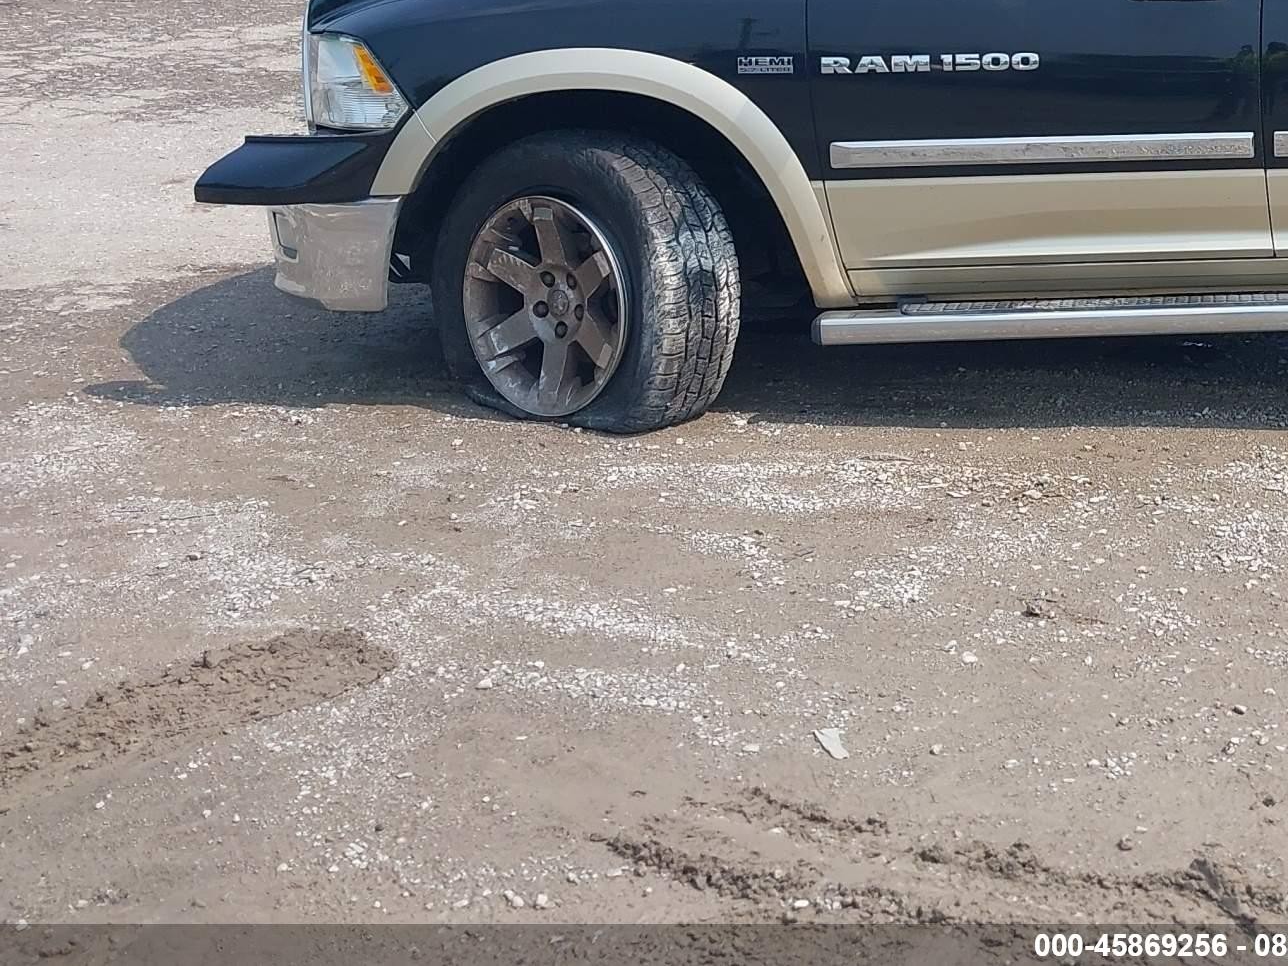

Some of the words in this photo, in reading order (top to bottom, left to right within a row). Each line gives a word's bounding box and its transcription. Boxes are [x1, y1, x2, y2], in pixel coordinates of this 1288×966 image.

[738, 56, 793, 67] HEMI
[820, 54, 931, 74] RAM
[940, 52, 1040, 72] 1500
